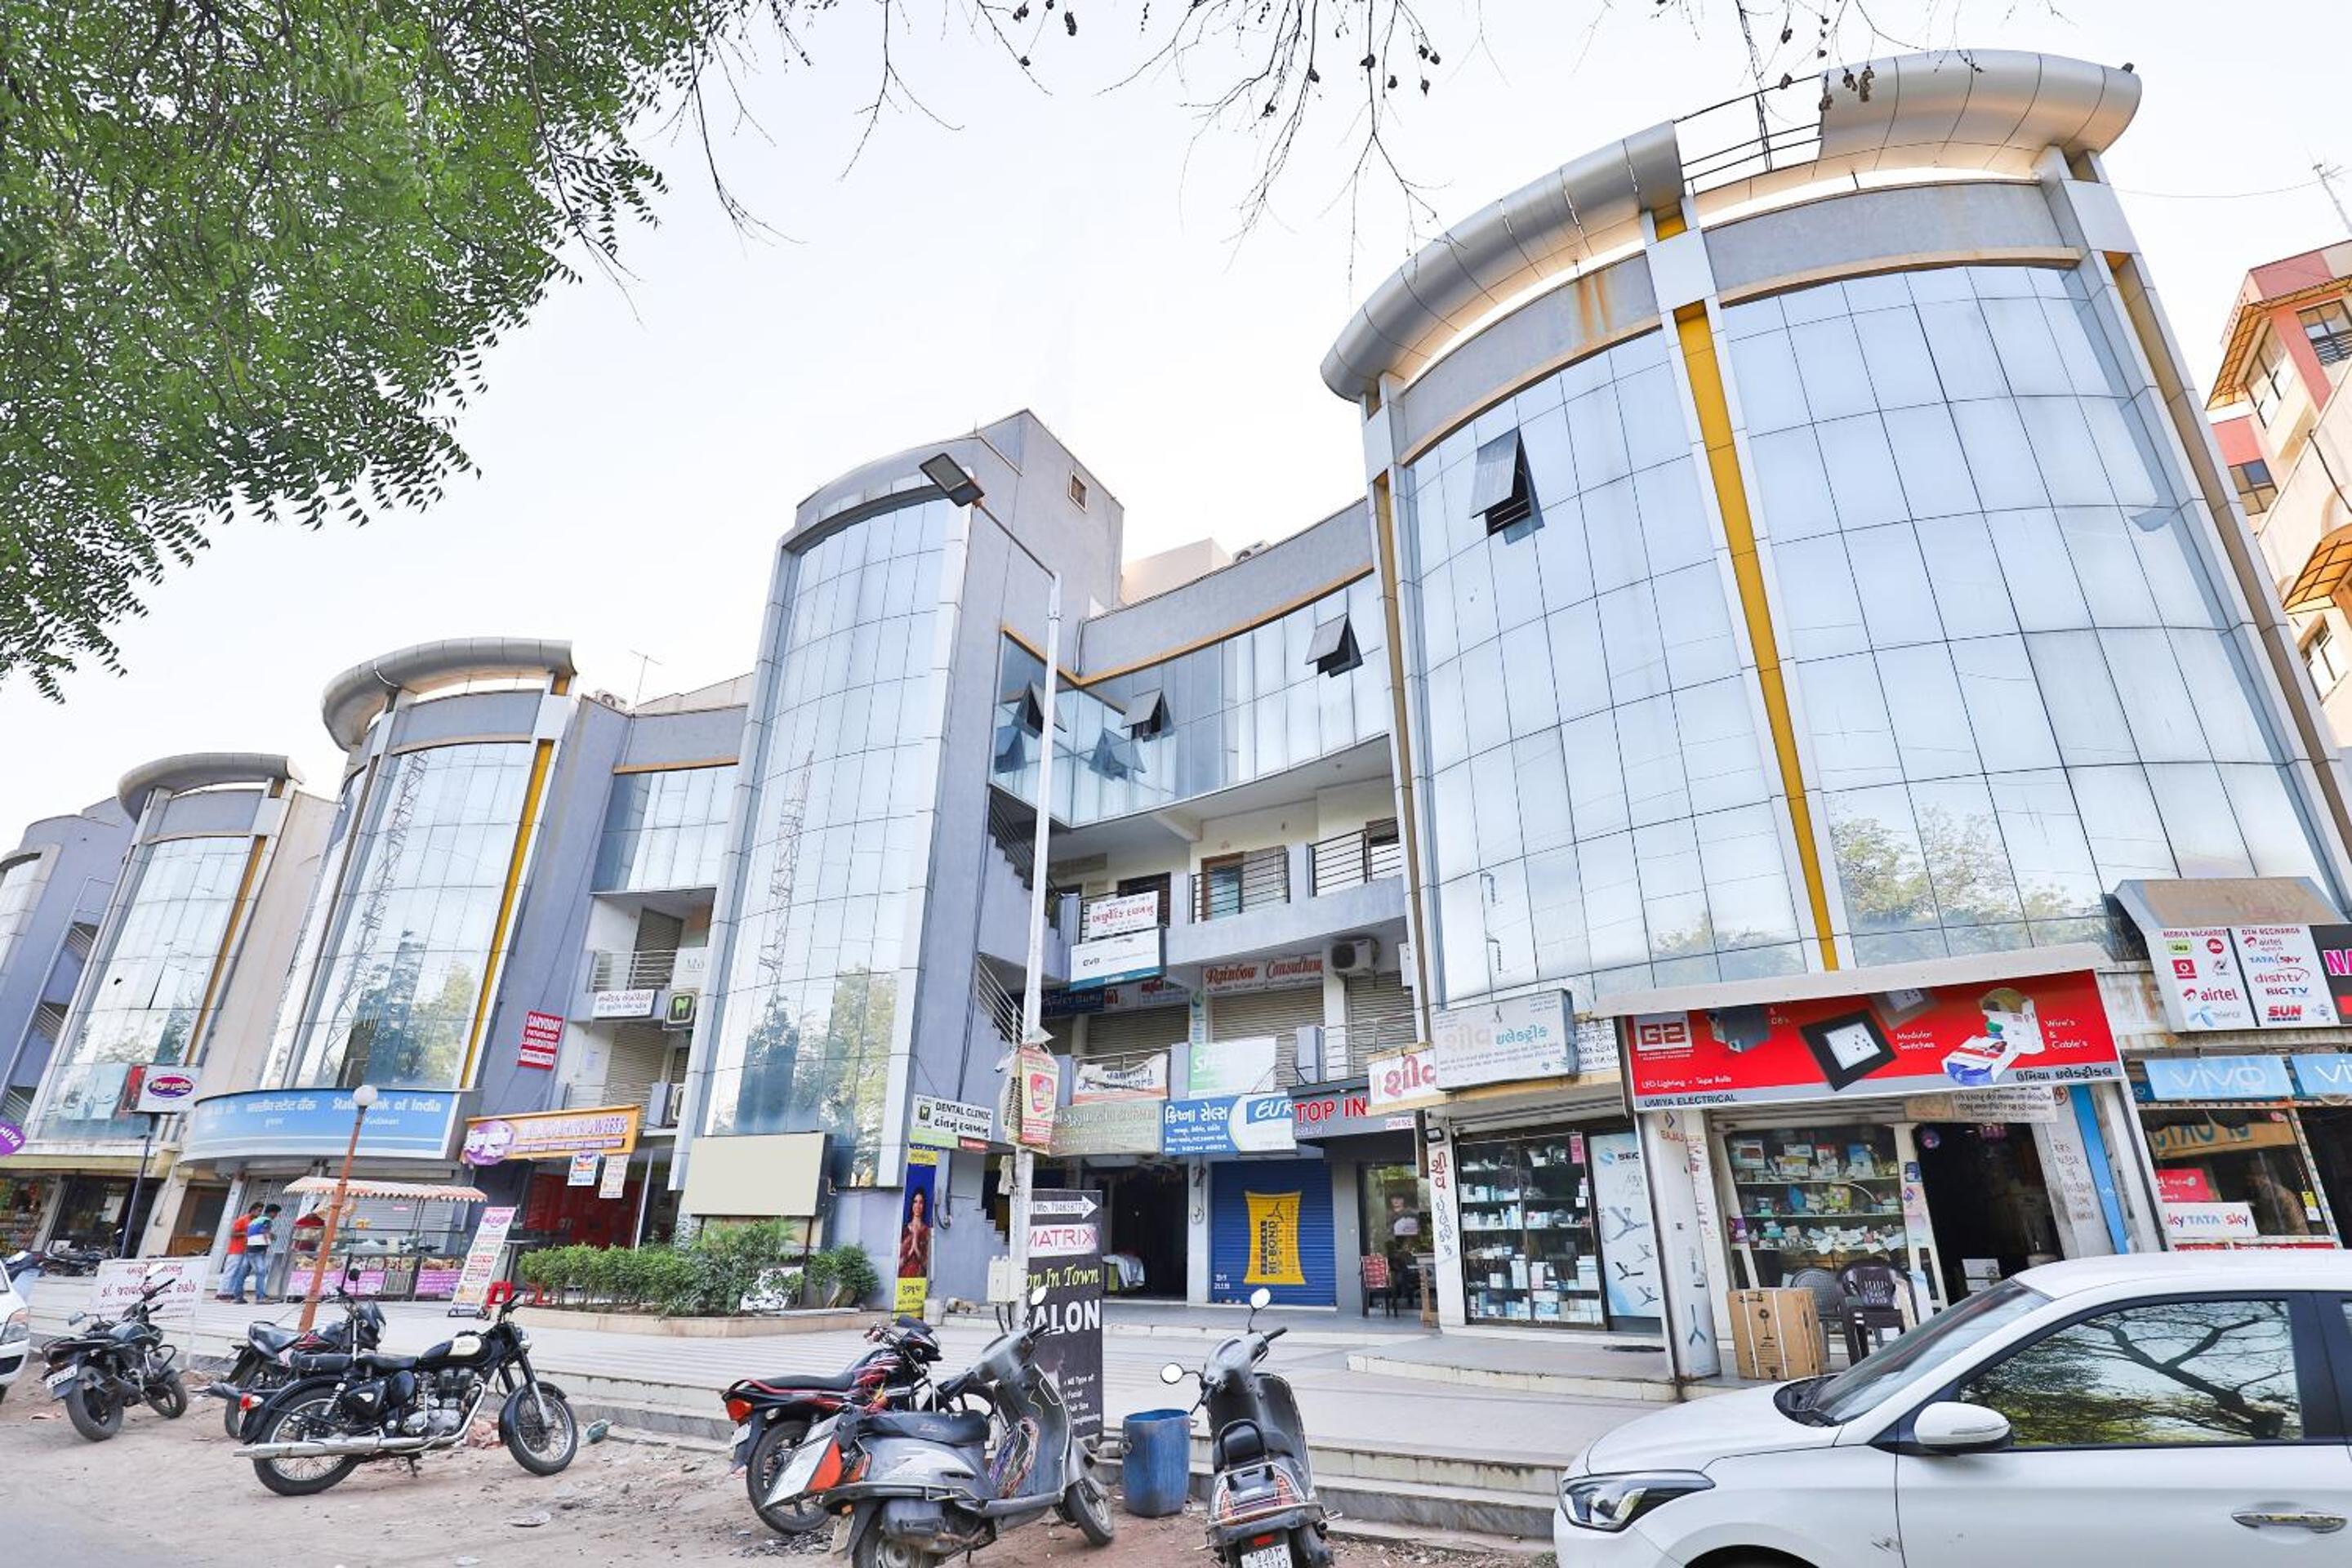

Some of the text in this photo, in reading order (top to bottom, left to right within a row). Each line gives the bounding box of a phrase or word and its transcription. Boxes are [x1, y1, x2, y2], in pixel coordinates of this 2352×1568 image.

[2171, 944, 2188, 952] idea
[2200, 987, 2238, 1002] airtel
[2267, 1005, 2302, 1017] SUN
[2048, 1031, 2057, 1039] &
[2051, 1039, 2088, 1049] Cable's
[2169, 1062, 2265, 1089] vivo
[394, 1098, 407, 1111] of
[411, 1098, 442, 1112] India
[1644, 1094, 1738, 1107] UMIYA ELECTRICAL
[935, 1102, 991, 1120] DENTAL CLINIC
[1295, 1096, 1368, 1124] TOP IN
[2187, 1214, 2221, 1224] TATA
[1267, 1220, 1277, 1275] HI-BOND
[1046, 1267, 1061, 1289] In
[1064, 1264, 1100, 1287] Town
[1027, 1298, 1101, 1337] ALON
